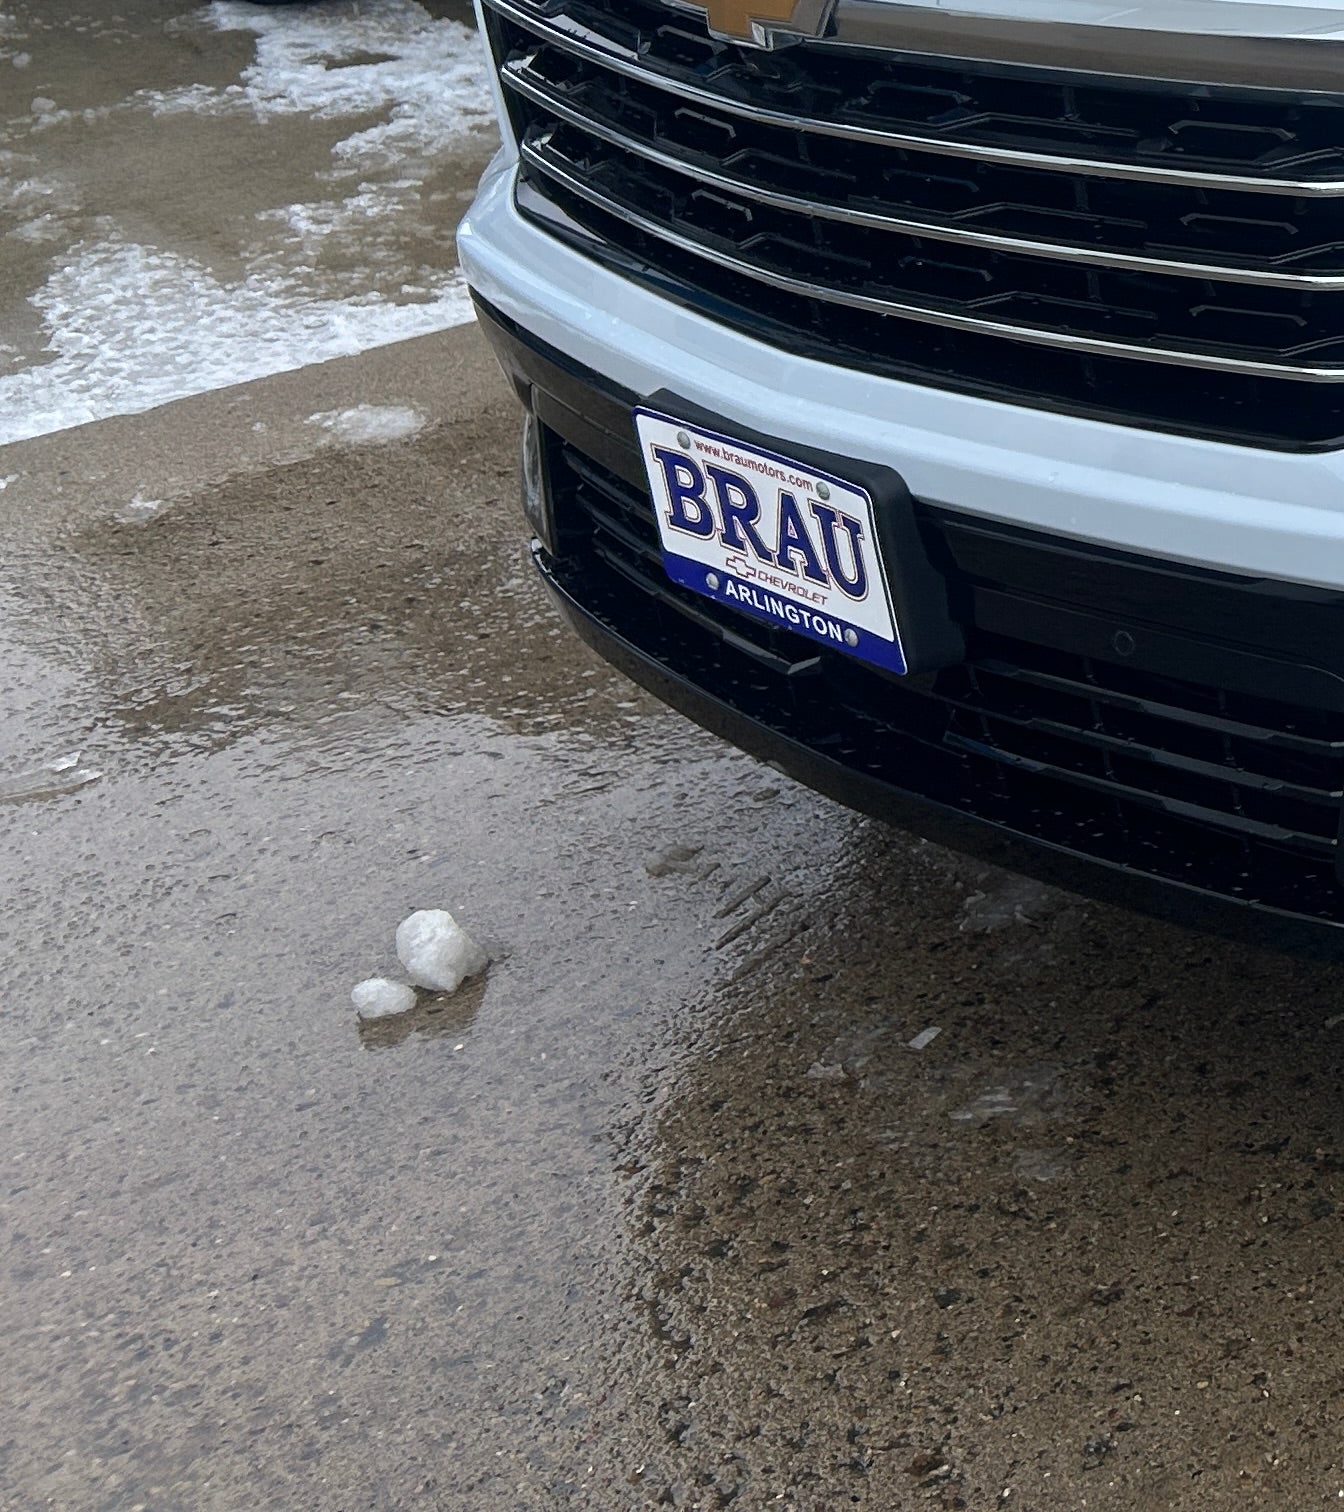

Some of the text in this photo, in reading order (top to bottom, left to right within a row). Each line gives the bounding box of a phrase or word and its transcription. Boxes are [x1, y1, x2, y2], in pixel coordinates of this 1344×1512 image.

[693, 438, 814, 493] www.braumotors.com
[650, 443, 870, 603] BRAU
[725, 579, 844, 643] ARLINGTON
[757, 571, 829, 606] CHEVROLET
